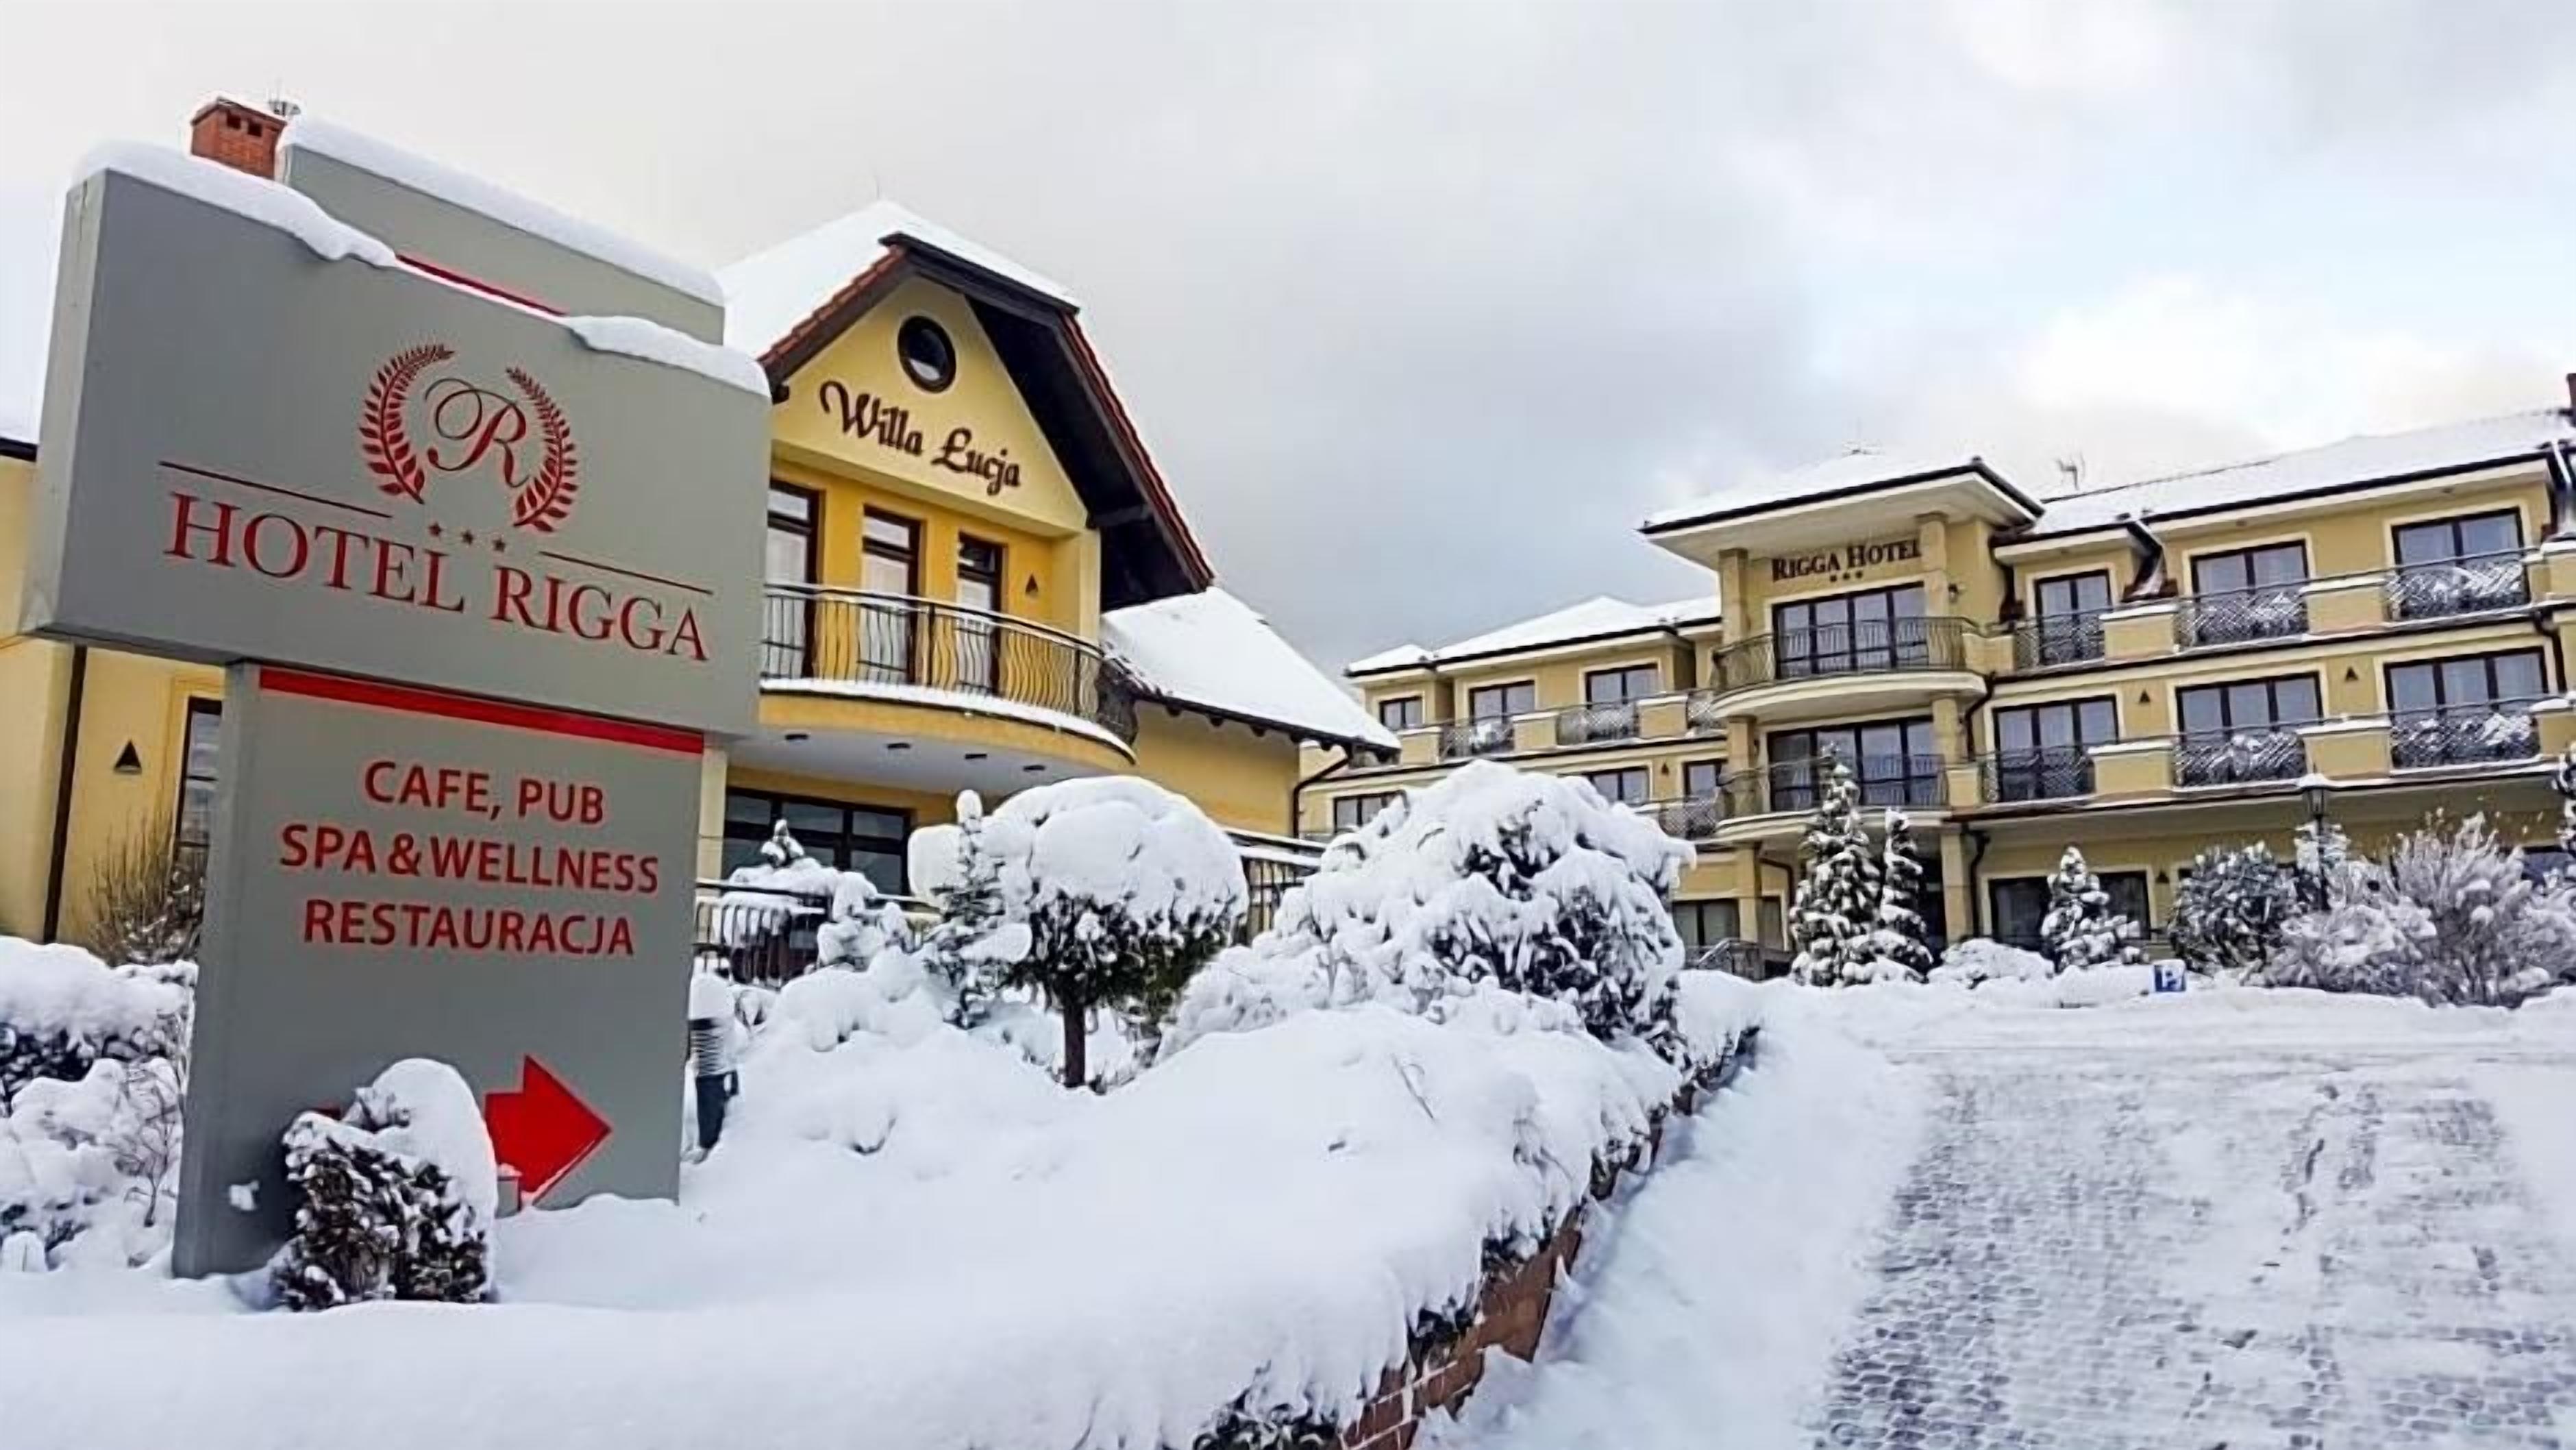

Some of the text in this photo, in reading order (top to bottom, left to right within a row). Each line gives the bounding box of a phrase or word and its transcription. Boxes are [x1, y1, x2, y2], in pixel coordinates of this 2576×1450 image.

[819, 380, 924, 456] Willa
[164, 491, 710, 662] HOTEL RIGGA
[1772, 539, 1922, 582] RIGGA HOTEL
[364, 761, 605, 824] CAFE, PUB
[304, 899, 634, 956] RESTAURACJA
